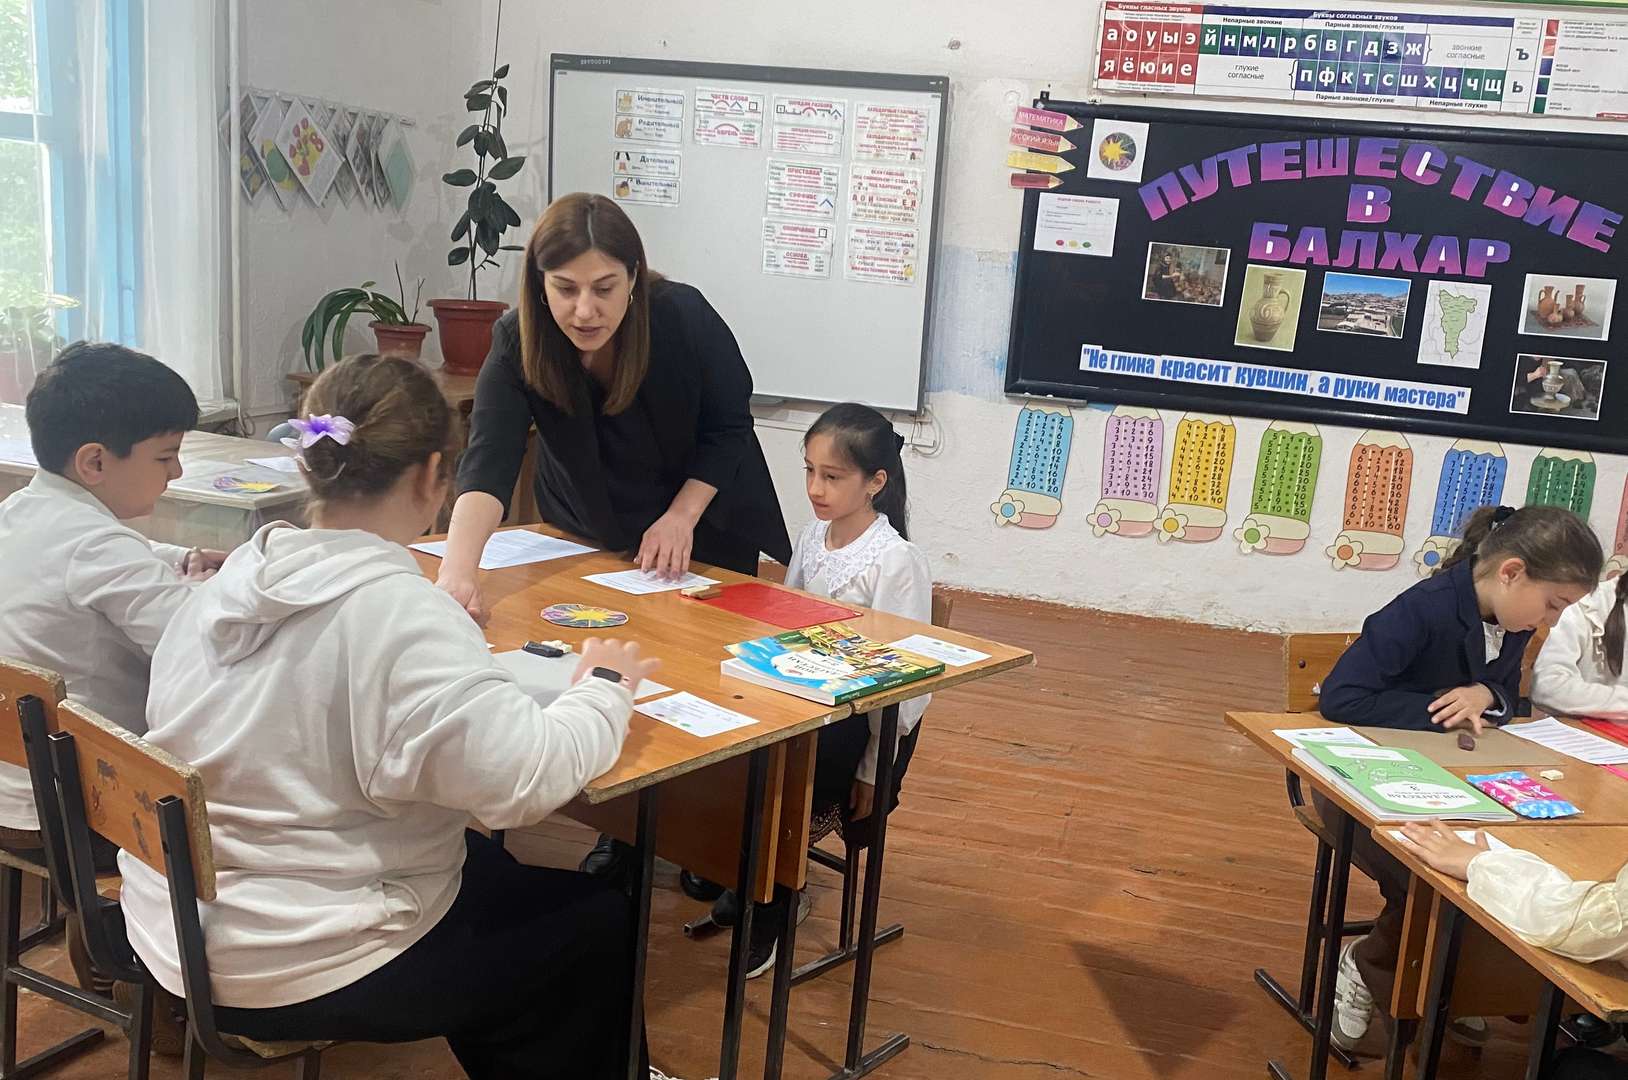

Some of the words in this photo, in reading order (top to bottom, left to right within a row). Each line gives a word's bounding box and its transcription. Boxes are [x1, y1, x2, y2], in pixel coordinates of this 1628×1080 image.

[1228, 71, 1264, 80] согласные
[1446, 52, 1485, 60] согласные
[1429, 100, 1463, 108] Непарные
[1137, 137, 1624, 253] ПУТЕШЕСТВИЕ
[1346, 184, 1392, 224] В
[1248, 222, 1512, 278] БАЛХАР
[1110, 354, 1155, 374] глина
[1160, 358, 1231, 383] красит
[1318, 376, 1330, 394] а
[1333, 377, 1380, 400] руки
[1384, 386, 1465, 409] мастера"
